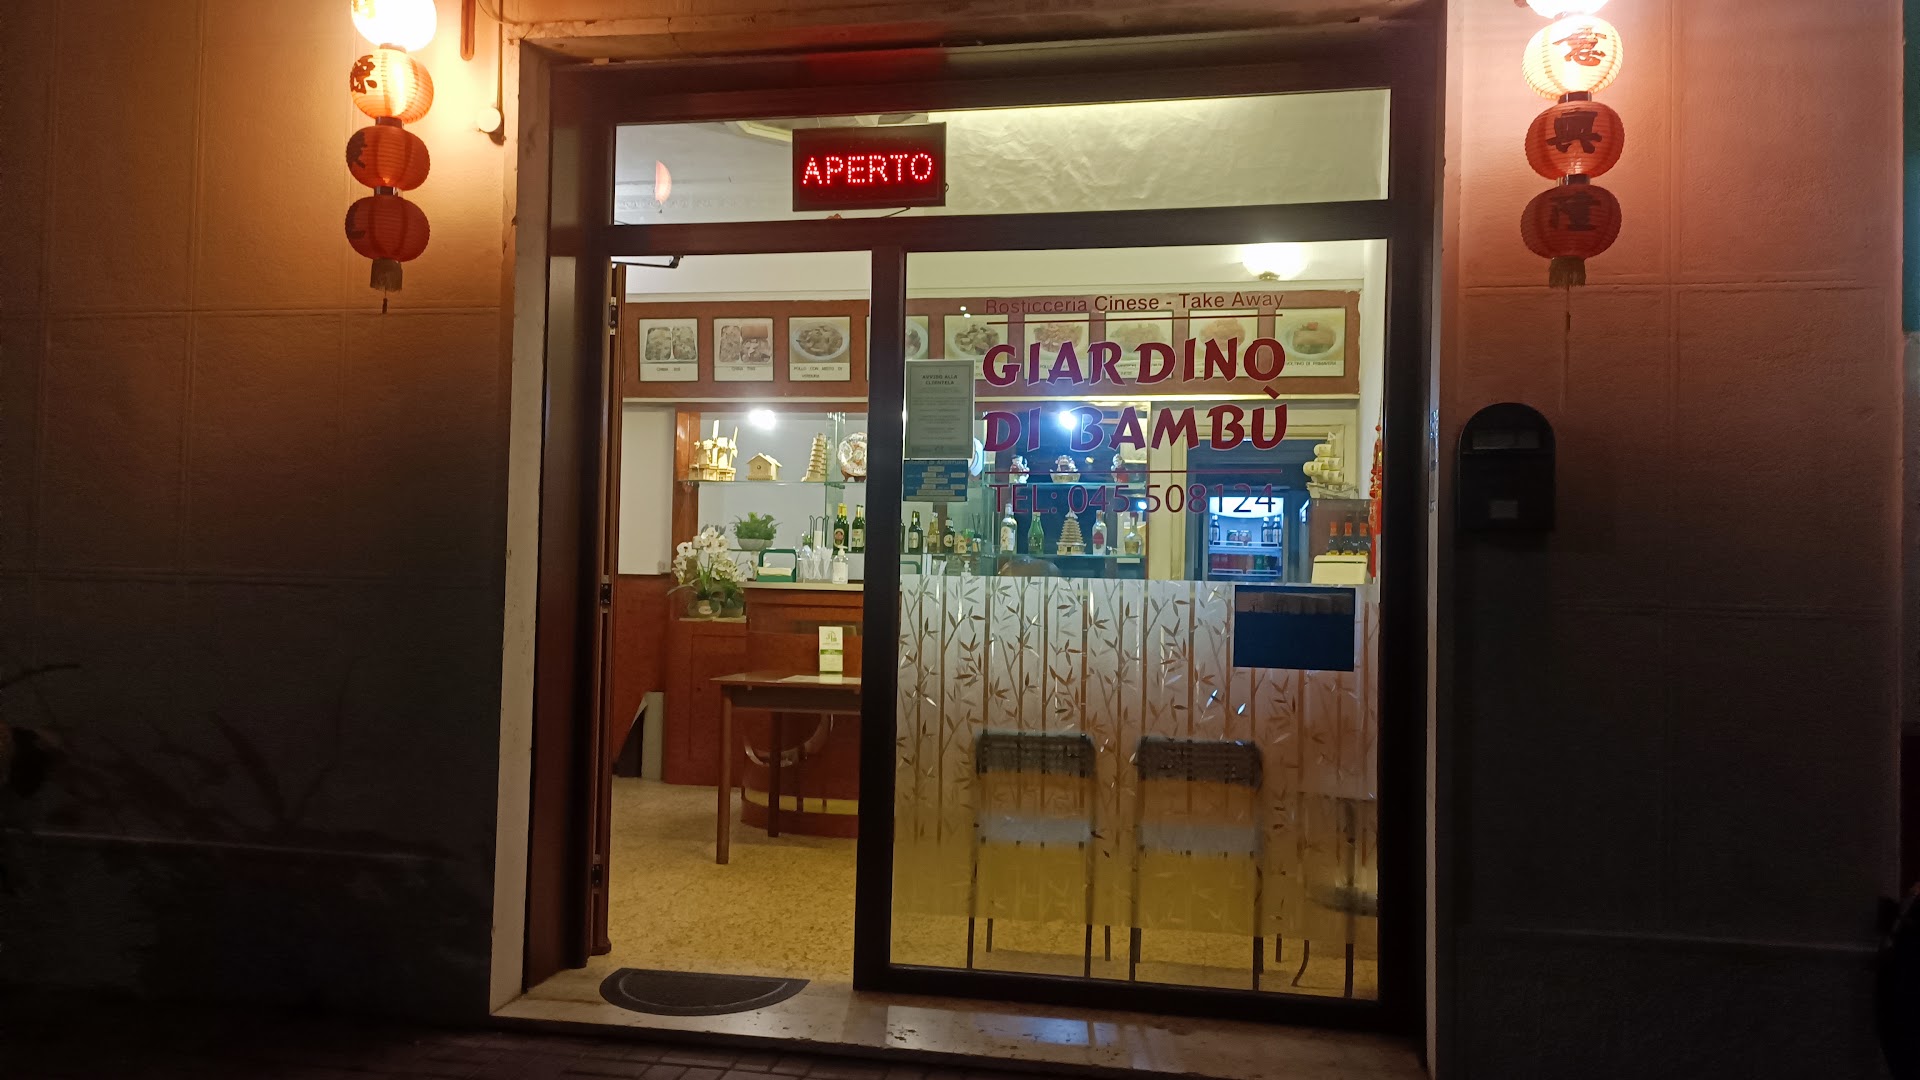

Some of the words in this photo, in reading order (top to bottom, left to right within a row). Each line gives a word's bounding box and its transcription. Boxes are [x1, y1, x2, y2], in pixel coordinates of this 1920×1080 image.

[802, 152, 933, 185] APERTO
[985, 298, 1088, 315] Rosticceria
[1094, 295, 1160, 312] Cinese
[1179, 292, 1225, 309] Take
[1231, 291, 1285, 310] Away
[982, 337, 1286, 387] GIARDINO
[983, 407, 1041, 452] DI
[1068, 385, 1288, 451] BAMBÙ
[988, 484, 1059, 513] TEL:
[1067, 484, 1131, 513] 045
[1146, 483, 1277, 513] 508124
